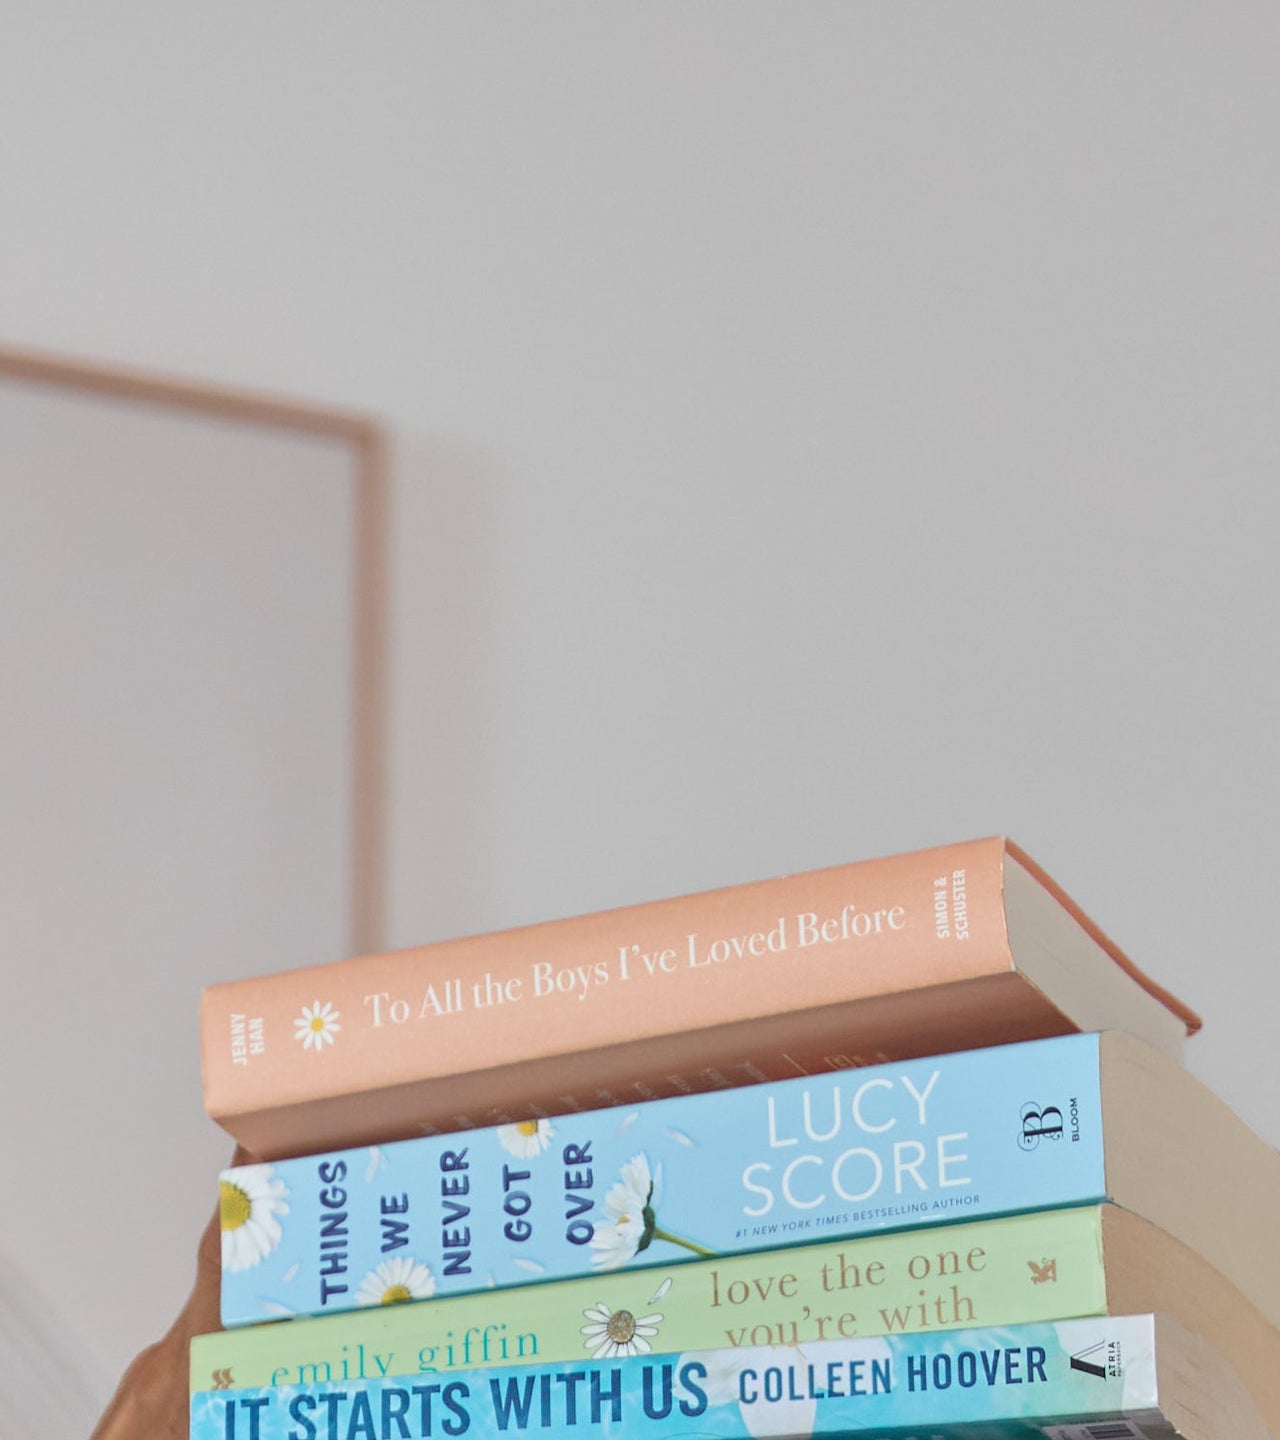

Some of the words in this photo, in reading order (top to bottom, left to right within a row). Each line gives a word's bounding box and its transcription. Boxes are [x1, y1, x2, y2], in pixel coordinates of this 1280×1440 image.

[934, 876, 948, 888] &
[953, 869, 969, 941] SCHUSTER
[935, 890, 951, 939] SIMON
[364, 992, 410, 1028] To
[419, 979, 462, 1018] All
[471, 972, 522, 1008] the
[532, 961, 609, 1000] Boys
[619, 945, 677, 981] I've
[688, 918, 787, 968] Loved
[797, 904, 906, 948] Before
[230, 1013, 248, 1066] JENNY
[250, 1016, 265, 1054] HAN
[767, 1070, 941, 1148] LUCY
[1070, 1096, 1080, 1142] BLOOM
[502, 1163, 533, 1242] GOT
[563, 1140, 595, 1246] OVER
[742, 1132, 972, 1217] SCORE
[318, 1159, 349, 1305] THINGS
[380, 1193, 410, 1253] WE
[440, 1147, 472, 1276] NEVER
[752, 1223, 779, 1236] NEW
[782, 1219, 812, 1232] YORK
[815, 1213, 849, 1227] TIMES
[852, 1201, 929, 1221] BESTSELLING
[931, 1194, 980, 1210] AUTHOR
[710, 1271, 799, 1308] love
[820, 1253, 886, 1293] the
[907, 1246, 987, 1282] one
[878, 1285, 978, 1333] with
[418, 1323, 539, 1373] giffin
[1108, 1341, 1117, 1377] ATRIA
[489, 1368, 623, 1432] WITH
[641, 1361, 709, 1420] US
[738, 1357, 893, 1404] COLLEEN
[907, 1345, 1049, 1393] HOOVER
